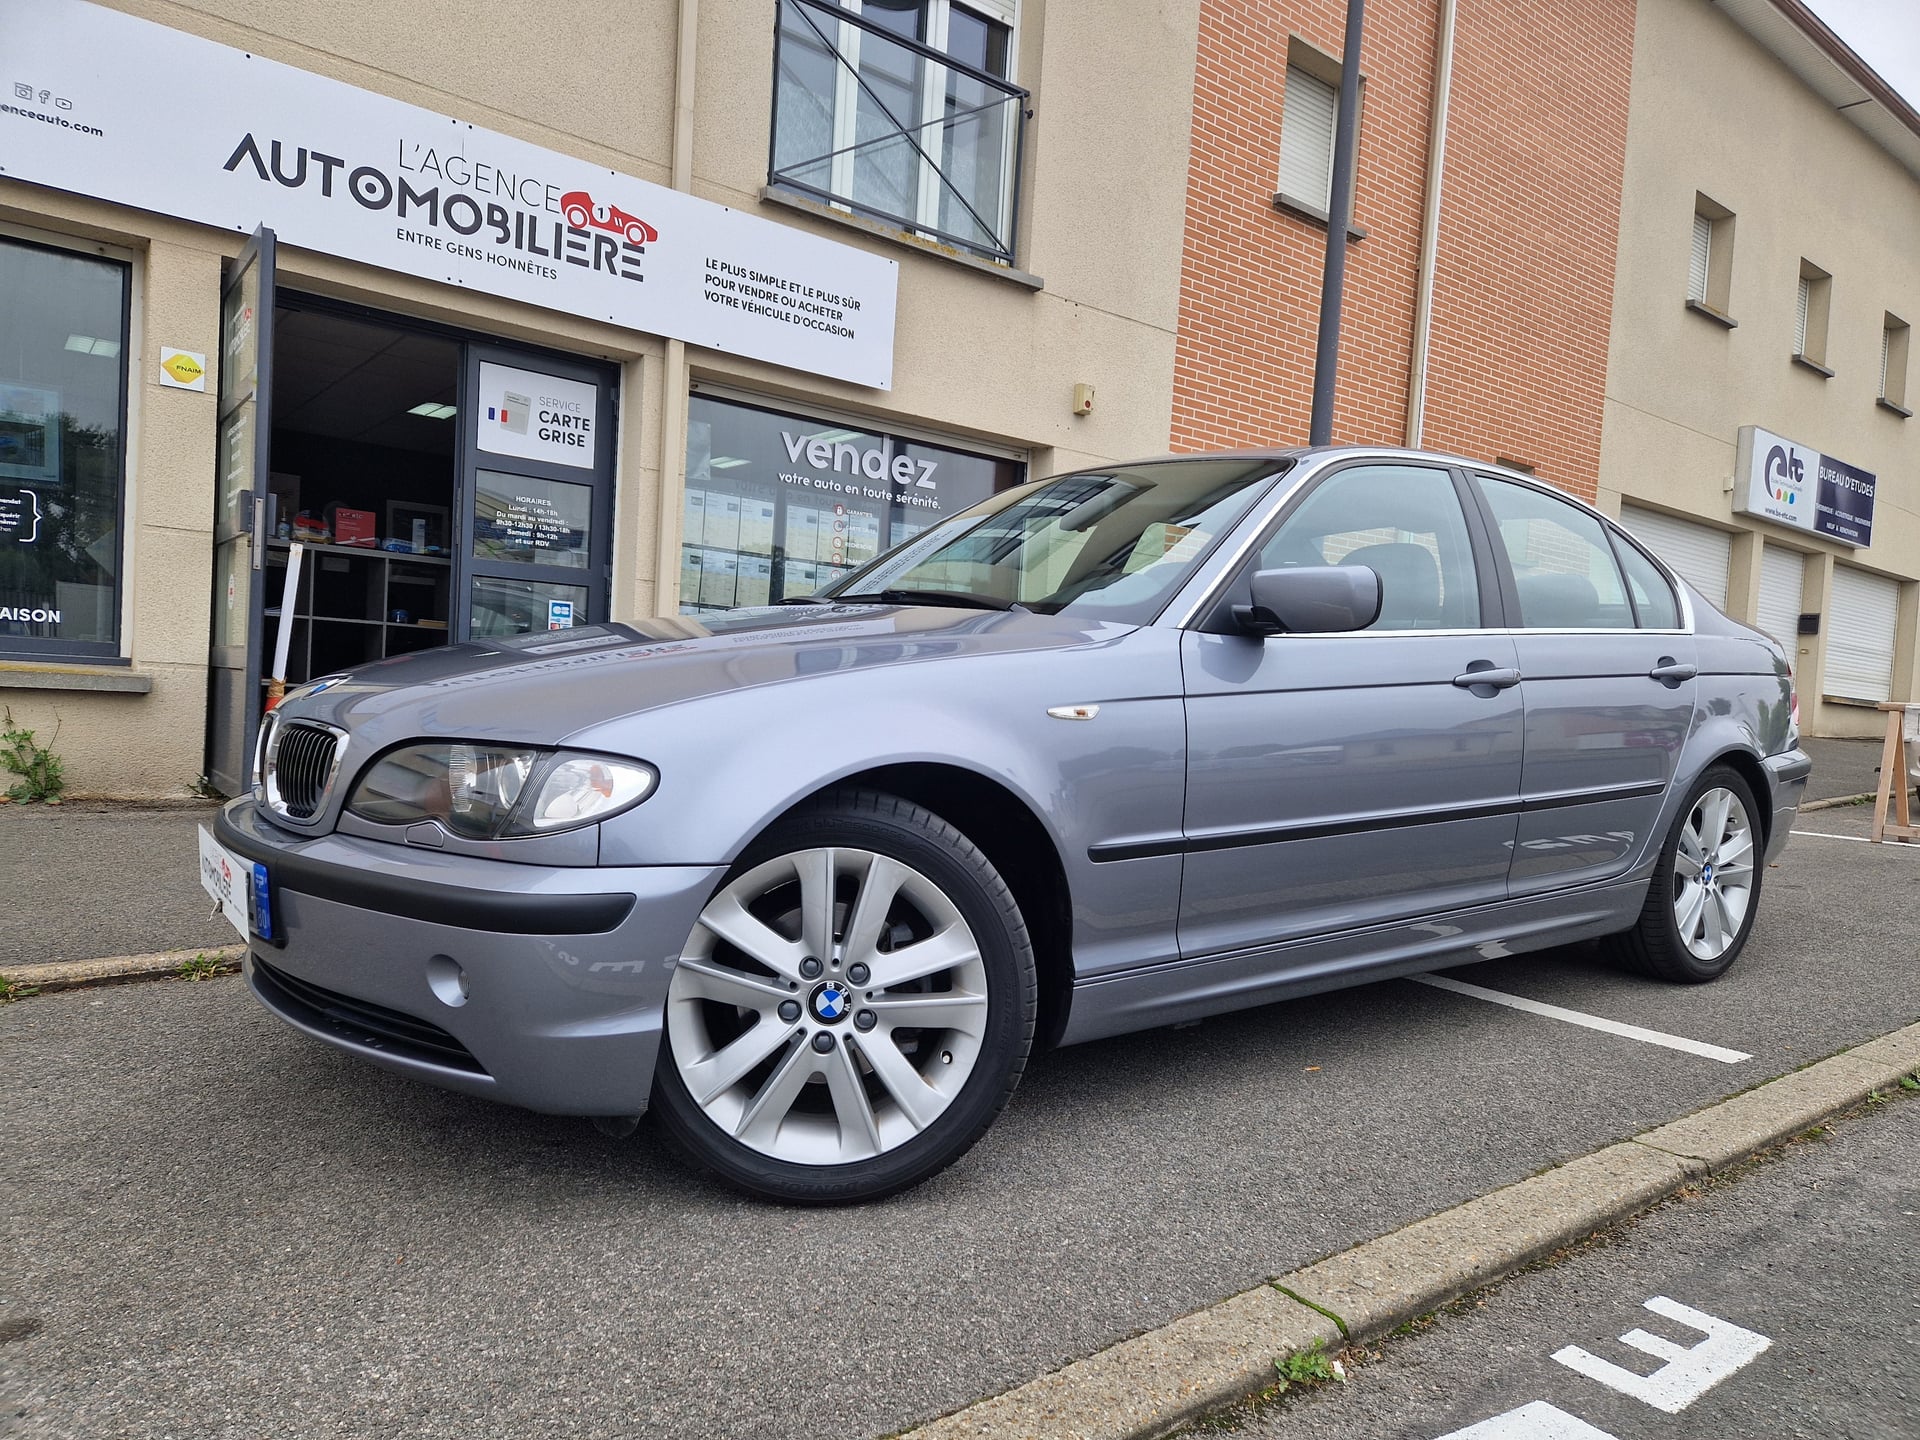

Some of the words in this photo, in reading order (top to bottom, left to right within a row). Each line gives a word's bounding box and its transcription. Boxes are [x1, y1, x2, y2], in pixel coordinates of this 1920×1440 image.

[0, 103, 104, 137] enceauto.com
[399, 138, 561, 214] L'AGENCE
[397, 228, 442, 250] ENTRE
[446, 242, 483, 261] GENS
[487, 251, 558, 280] HONNÊTES
[705, 258, 718, 270] LE
[720, 262, 747, 278] PLUS
[749, 270, 787, 291] SIMPLE
[789, 282, 802, 294] ET
[803, 286, 814, 298] LE
[816, 290, 840, 305] PLUS
[842, 297, 861, 311] SÛR
[705, 274, 736, 291] POUR
[738, 283, 779, 304] VENDRE
[781, 296, 797, 308] OU
[798, 301, 843, 322] ACHETER
[704, 290, 739, 309] VOTRE
[741, 300, 791, 323] VÉHICULE
[793, 314, 856, 340] D'OCCASION
[176, 365, 202, 374] FNAIM
[539, 397, 581, 413] SERVICE
[538, 410, 591, 432] CARTE
[538, 428, 586, 448] GRISE
[781, 432, 938, 490] vendez
[778, 472, 810, 486] votre
[814, 478, 841, 492] auto
[845, 484, 859, 495] en
[863, 486, 893, 501] toute
[896, 491, 941, 510] sérénité.
[1819, 466, 1844, 487] BUREAU
[1845, 476, 1874, 498] D'ETUDES
[508, 504, 527, 512] Lundi
[515, 496, 552, 506] HORAIRES
[507, 528, 531, 537] Samedi
[537, 517, 565, 525] vendredi
[826, 982, 852, 1012] BMW
